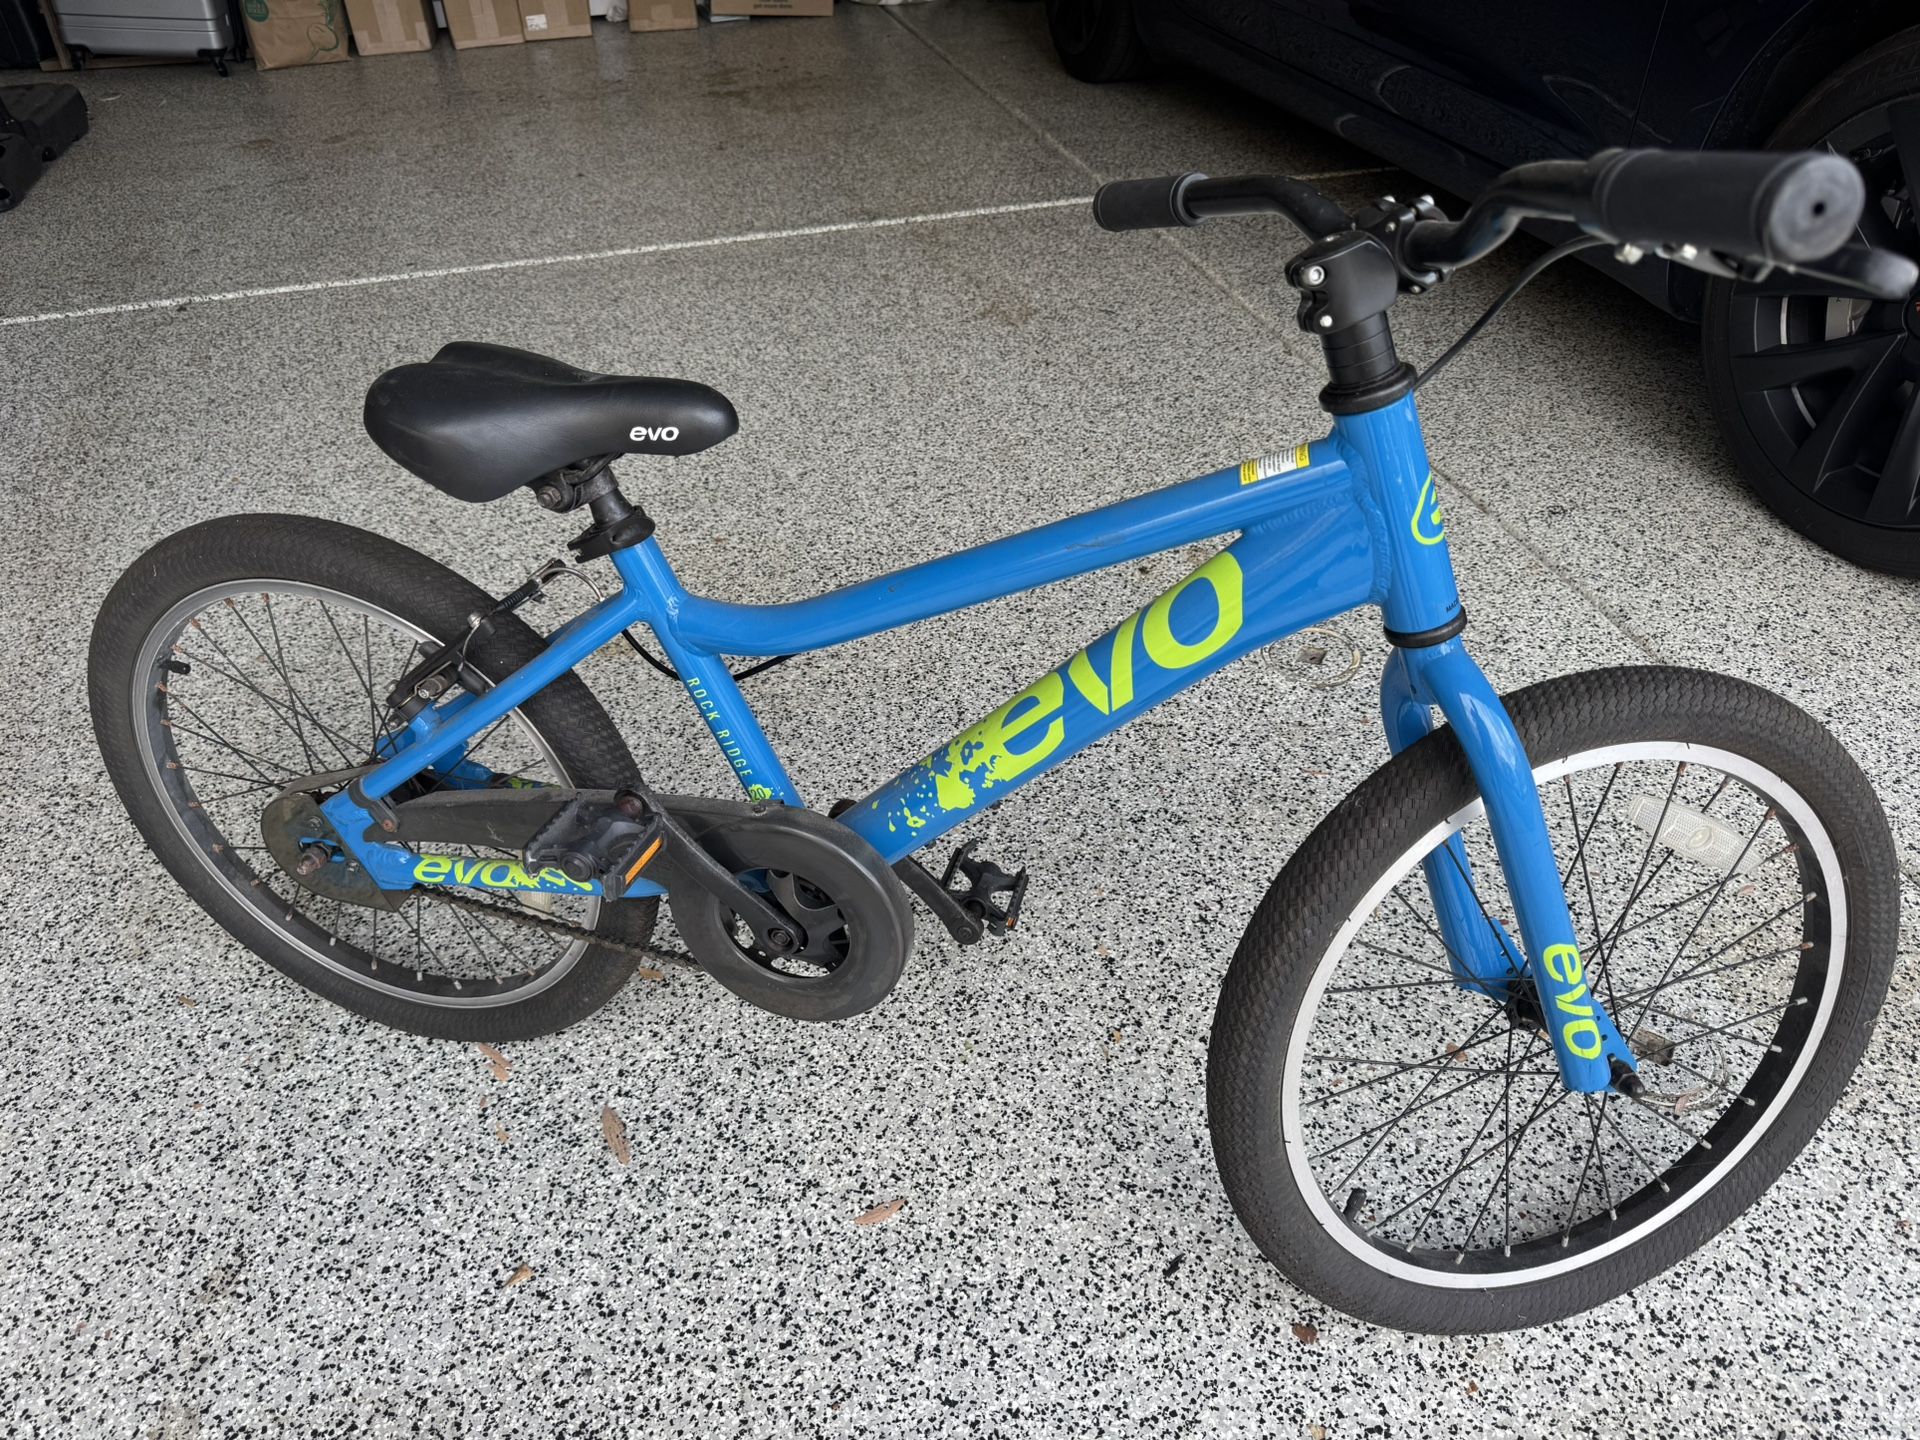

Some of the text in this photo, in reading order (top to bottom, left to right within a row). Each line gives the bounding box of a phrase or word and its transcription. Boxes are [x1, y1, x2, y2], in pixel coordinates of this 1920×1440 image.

[629, 426, 680, 441] evo
[972, 551, 1243, 782] evo
[687, 677, 753, 777] ROCK RIDGE
[751, 787, 766, 801] 20
[413, 854, 521, 888] evo
[1543, 943, 1602, 1060] evo
